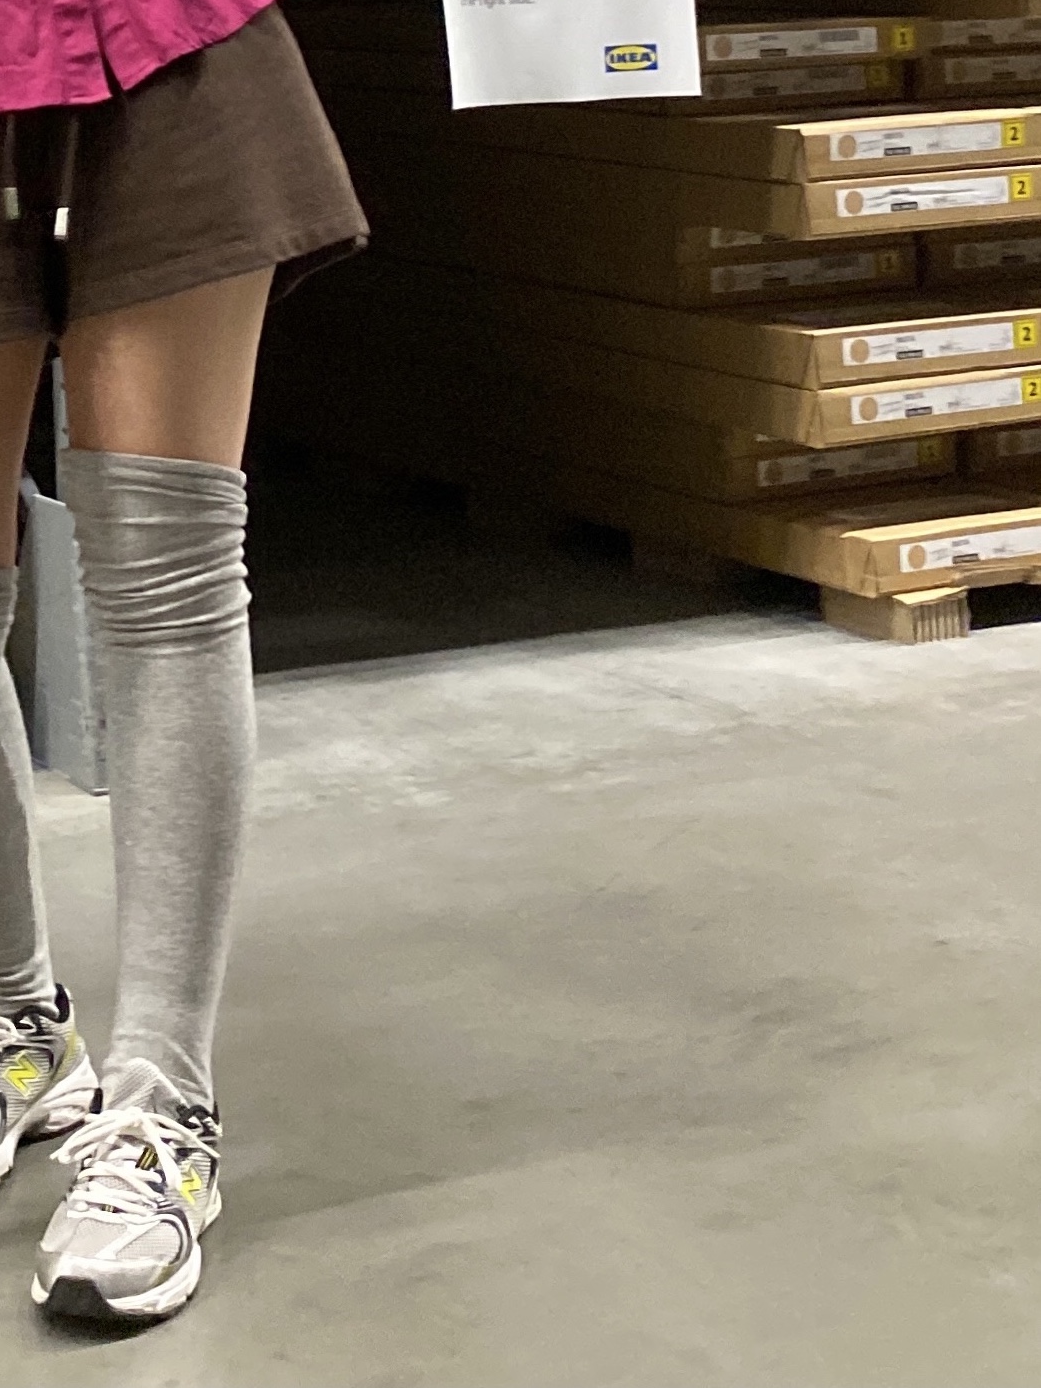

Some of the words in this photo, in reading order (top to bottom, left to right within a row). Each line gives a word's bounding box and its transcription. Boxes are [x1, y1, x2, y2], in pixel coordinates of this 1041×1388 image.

[609, 51, 654, 64] IKEA
[1009, 126, 1019, 141] 2
[1017, 180, 1027, 195] 2
[1022, 326, 1032, 342] 2
[1028, 381, 1038, 397] 2
